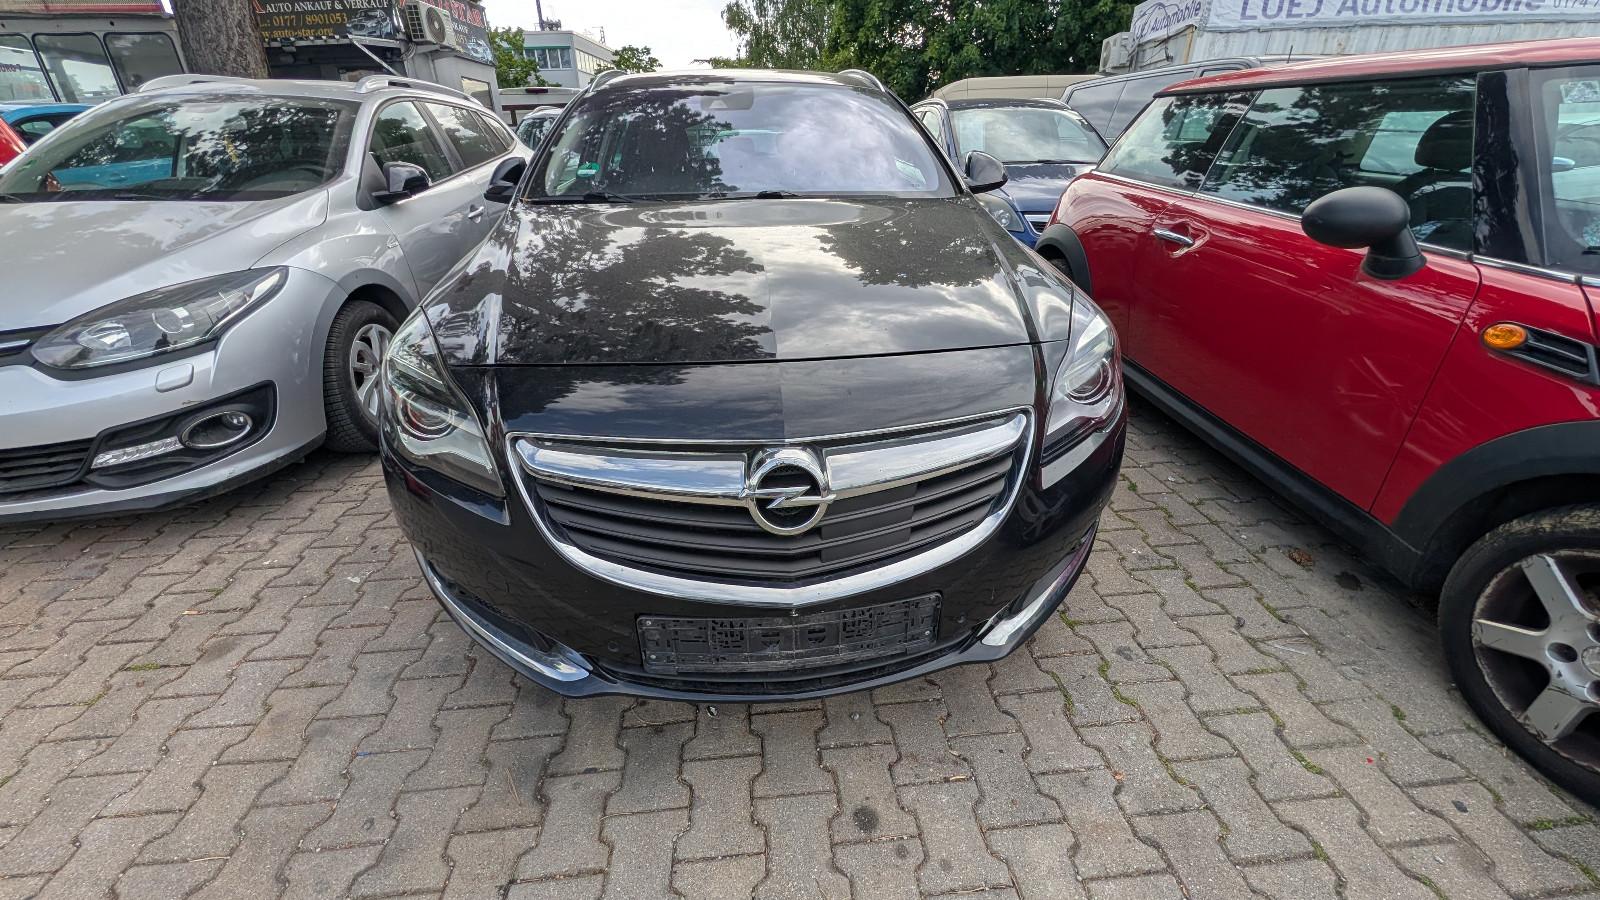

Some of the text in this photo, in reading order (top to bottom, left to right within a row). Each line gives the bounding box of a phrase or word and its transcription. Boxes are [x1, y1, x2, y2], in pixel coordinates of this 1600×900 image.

[266, 3, 292, 13] AUTO
[294, 1, 332, 12] ANKAUF
[334, 0, 343, 10] &
[343, 0, 389, 9] VERKAUF
[272, 15, 297, 27] 0177
[305, 12, 348, 26] 8901053
[261, 28, 334, 38] w.auto-star.org
